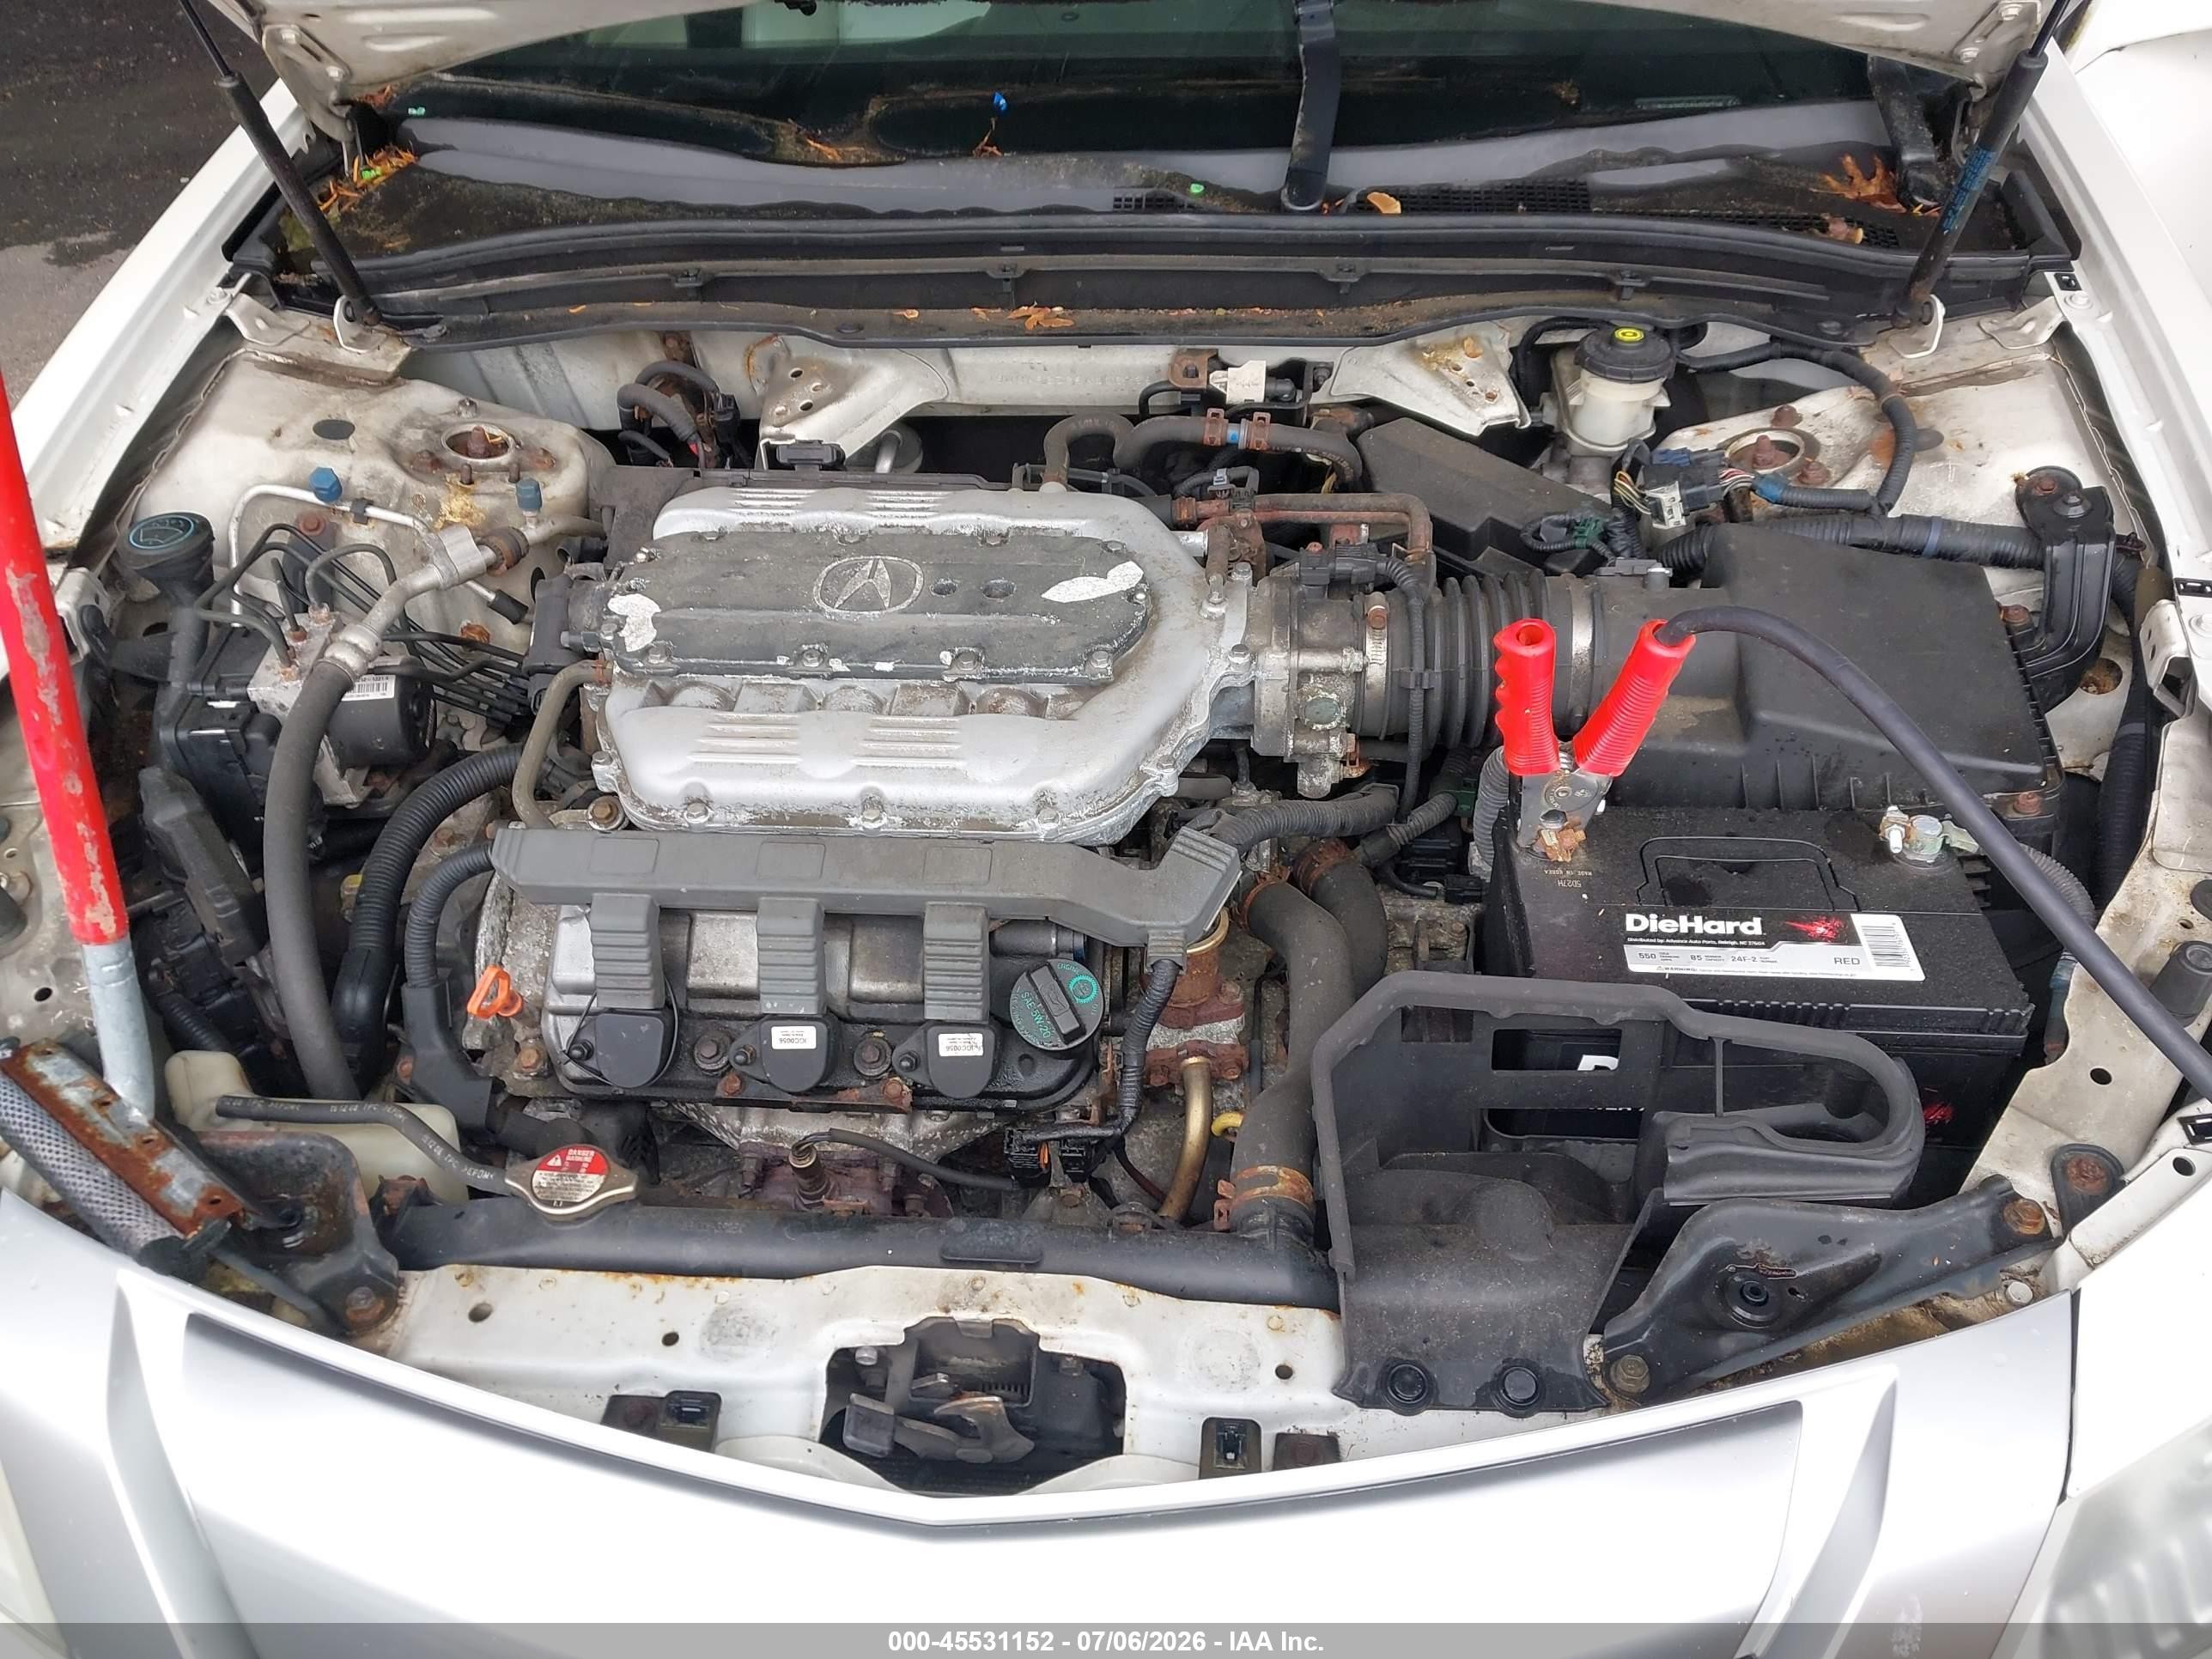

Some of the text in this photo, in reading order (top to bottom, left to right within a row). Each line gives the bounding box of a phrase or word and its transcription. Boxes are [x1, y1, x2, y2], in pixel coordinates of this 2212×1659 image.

[1626, 913, 1763, 935] DieHard
[1833, 957, 1861, 965] RED
[1021, 991, 1036, 1010] SAE
[1030, 1008, 1051, 1038] 5W-20
